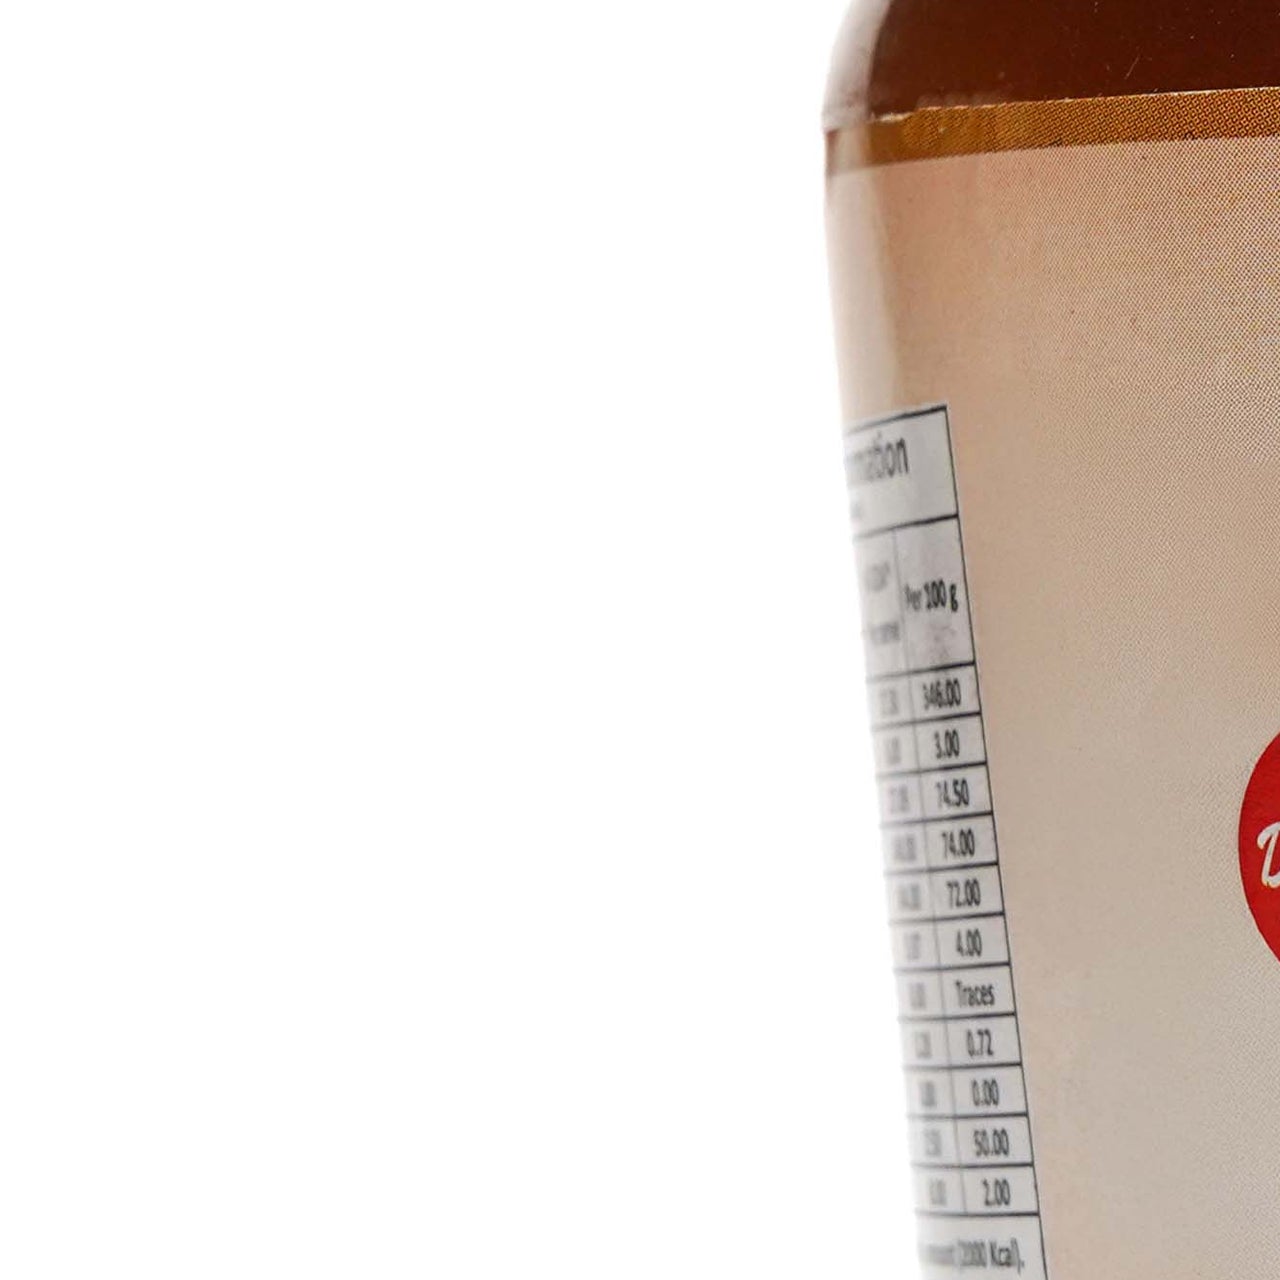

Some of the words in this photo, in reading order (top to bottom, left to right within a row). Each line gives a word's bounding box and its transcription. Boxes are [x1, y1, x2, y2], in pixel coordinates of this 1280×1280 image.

[923, 578, 947, 611] 100
[933, 728, 960, 760] 3.00
[941, 827, 976, 858] 74.00
[946, 877, 981, 908] 72.00
[956, 928, 983, 957] 4.00
[954, 979, 995, 1007] Traces
[966, 1029, 993, 1057] 0.72
[971, 1079, 1000, 1106] 0.00
[974, 1129, 1010, 1157] 50.00
[982, 1178, 1011, 1206] 2.00
